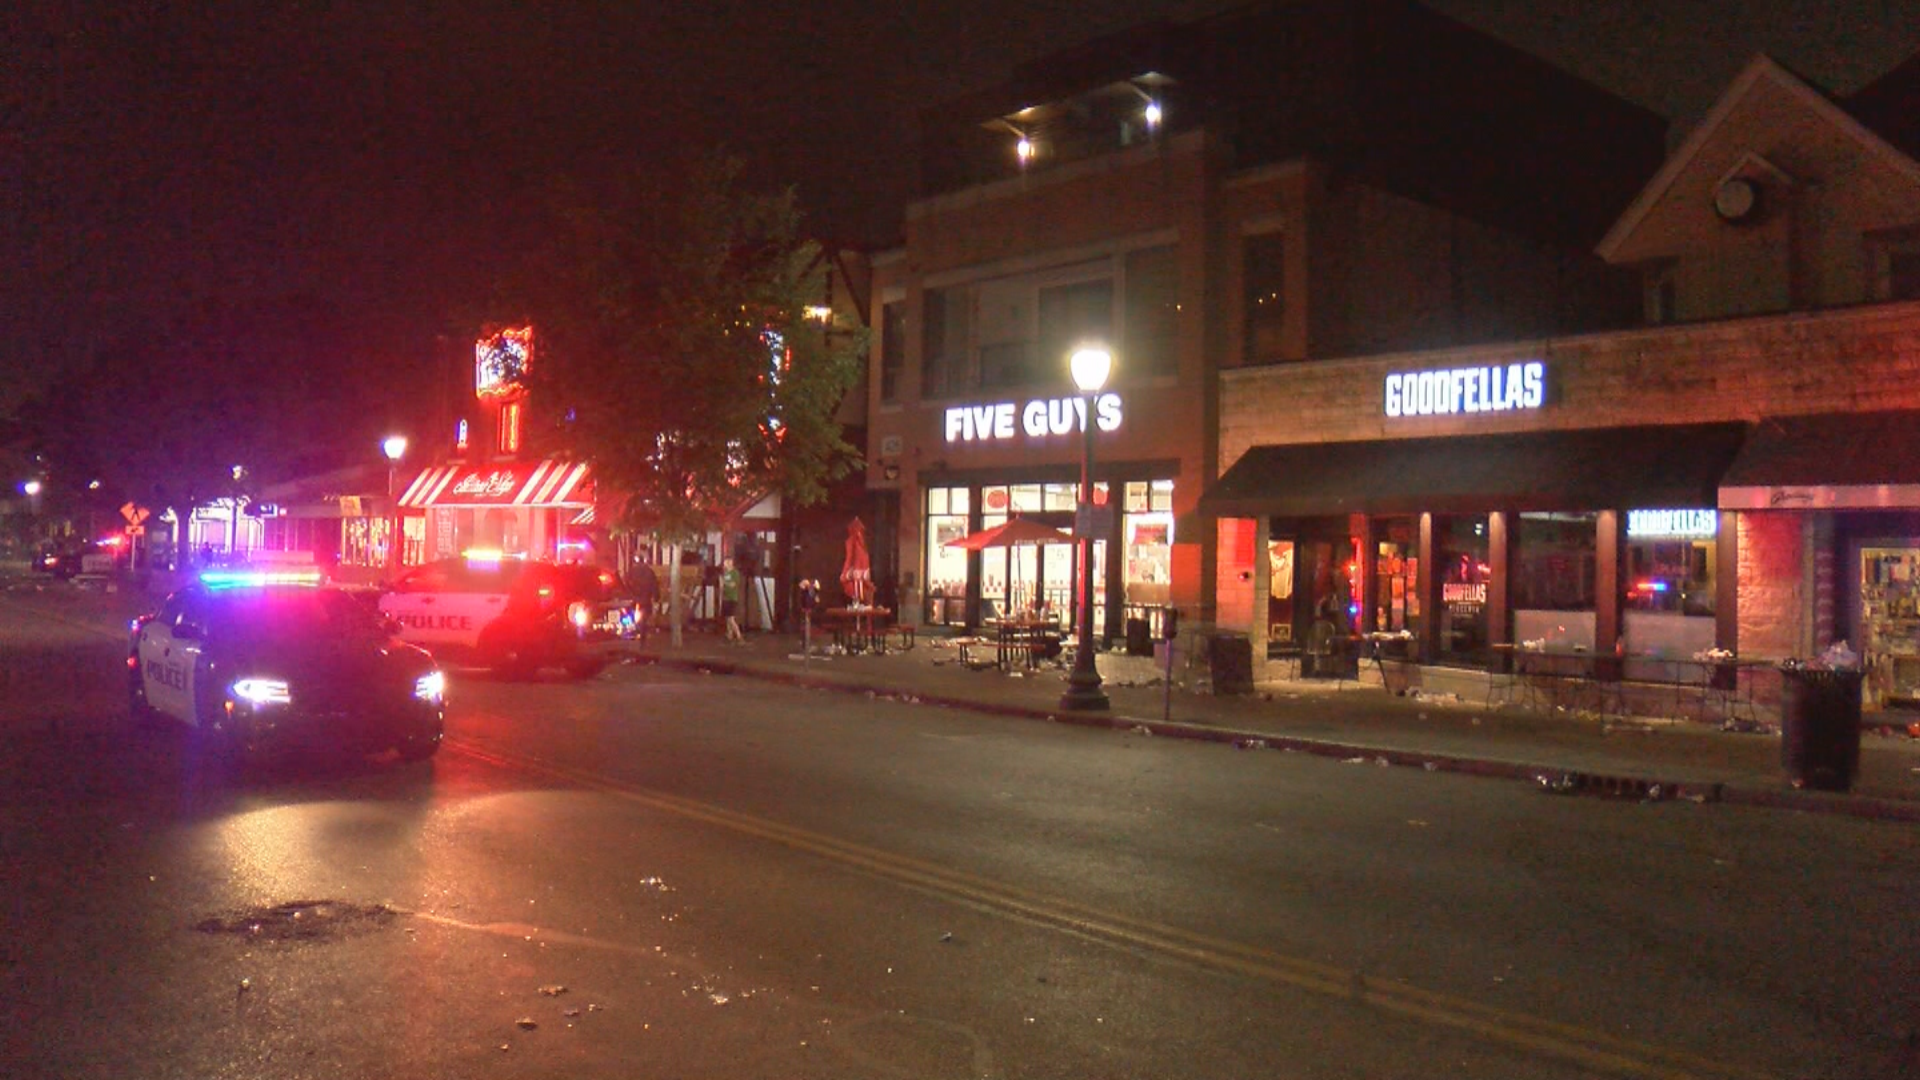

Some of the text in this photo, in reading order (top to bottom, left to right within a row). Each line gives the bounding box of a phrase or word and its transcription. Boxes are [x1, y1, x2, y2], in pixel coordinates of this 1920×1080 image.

[1386, 363, 1545, 417] GOODFELLAS
[945, 403, 1014, 442] FIVE
[147, 659, 183, 690] POLICE
